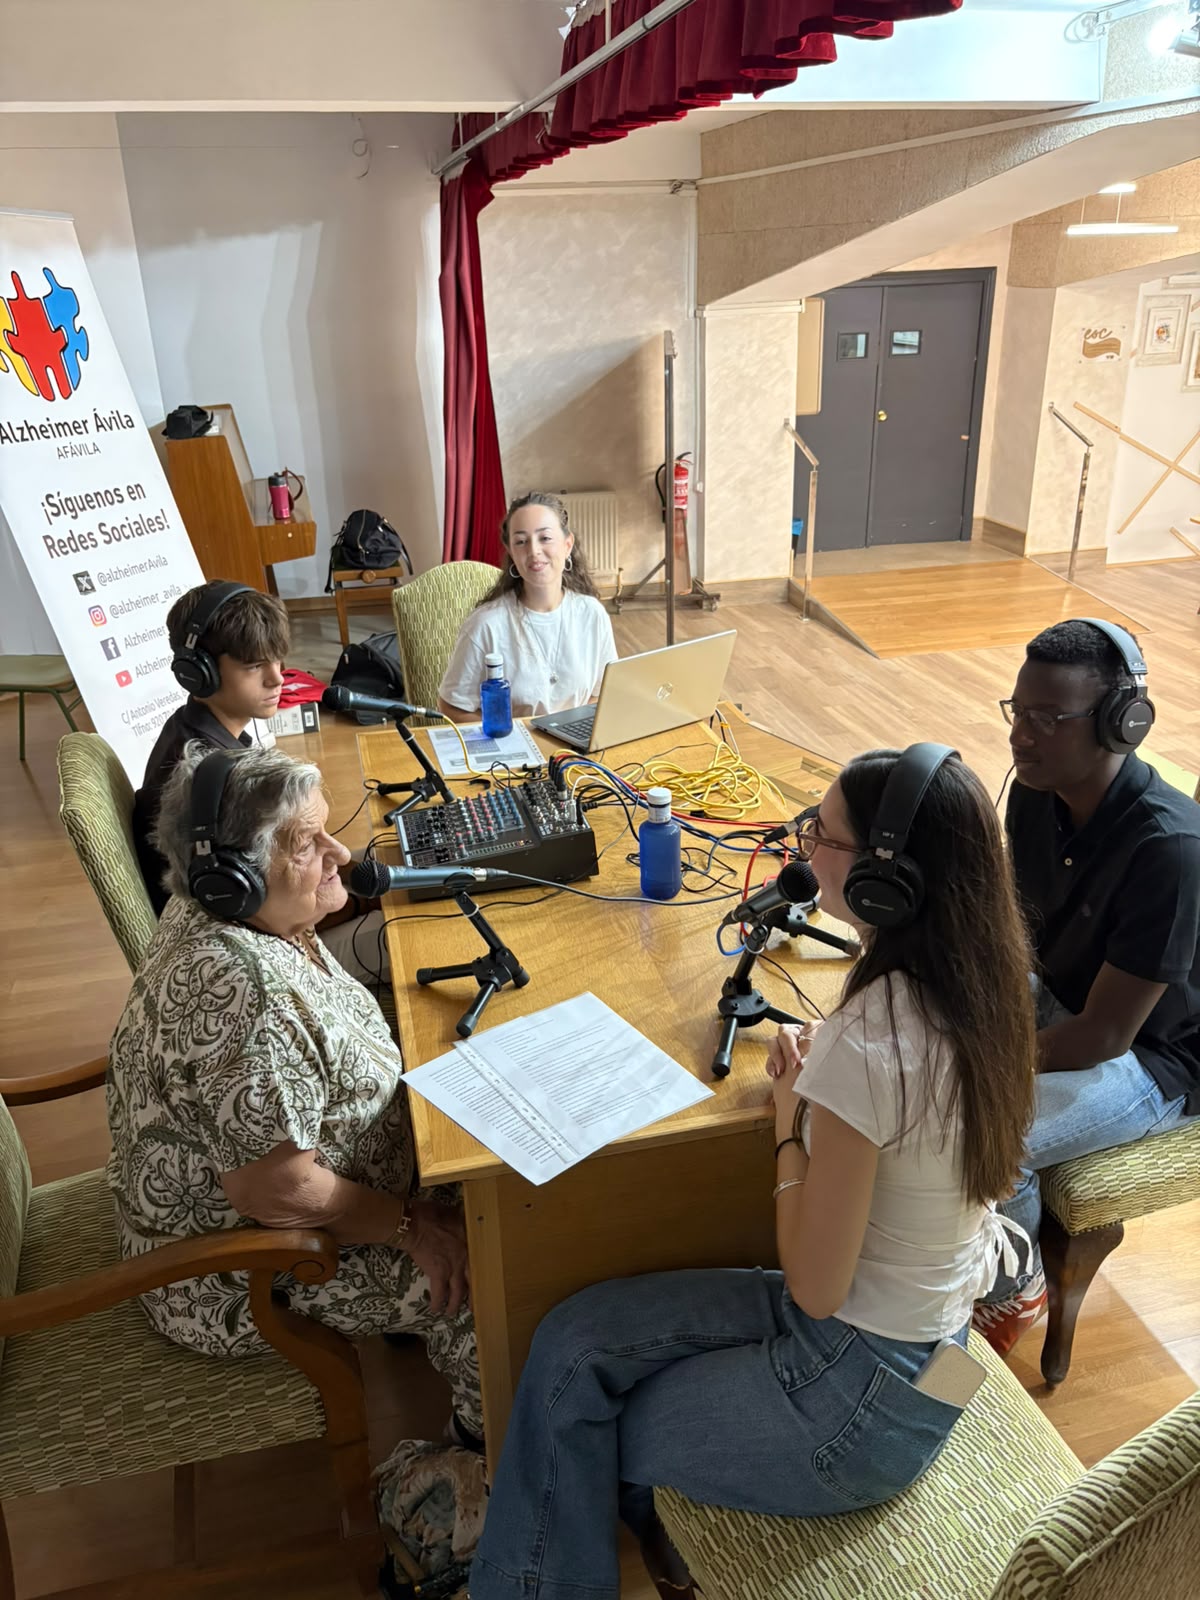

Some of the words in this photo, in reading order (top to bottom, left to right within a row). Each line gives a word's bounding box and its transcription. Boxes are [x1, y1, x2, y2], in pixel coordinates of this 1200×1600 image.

[0, 417, 89, 445] Alzheimer
[93, 407, 135, 433] Ávila
[57, 441, 101, 460] AFÁVILA
[41, 485, 124, 526] ¡Síguenos
[126, 482, 146, 501] en
[42, 530, 98, 559] Redes
[98, 508, 171, 545] Sociales!
[109, 584, 182, 618] @alzheimer_avila
[124, 626, 166, 649] Alzheimer
[135, 655, 173, 678] Alzheime
